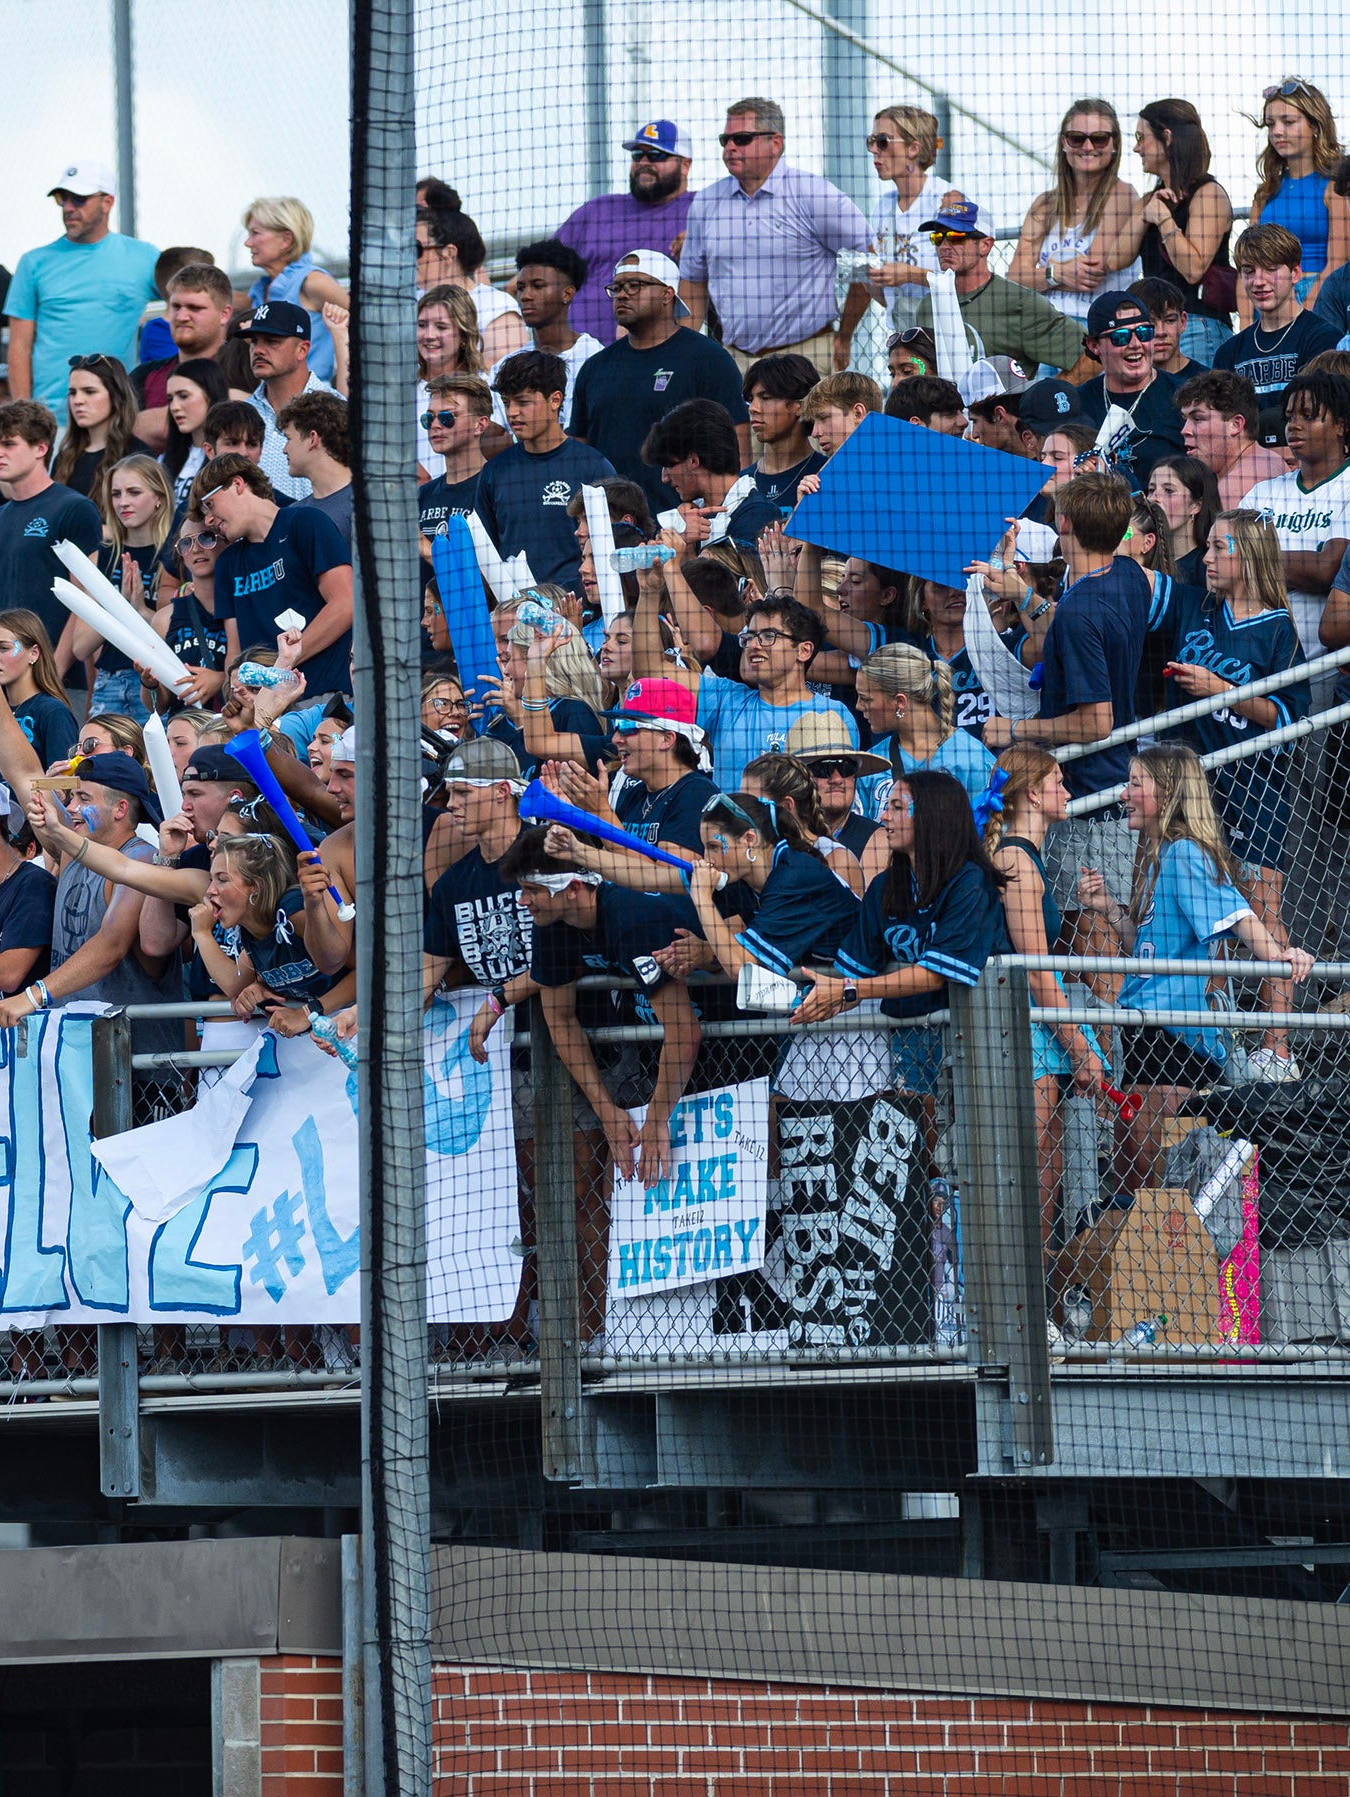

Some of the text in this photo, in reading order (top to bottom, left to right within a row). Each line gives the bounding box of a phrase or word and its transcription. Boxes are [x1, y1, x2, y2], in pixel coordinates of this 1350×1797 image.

[1054, 391, 1071, 414] B
[419, 507, 448, 523] ARBE
[1176, 629, 1252, 686] Bucs
[957, 692, 996, 727] 29
[669, 1092, 734, 1149] ET'S
[735, 1129, 757, 1155] TAKE
[643, 1152, 738, 1216] MAKE
[779, 1113, 845, 1347] REBS!
[838, 1098, 919, 1347] BEAT the
[617, 1217, 761, 1290] HISTORY
